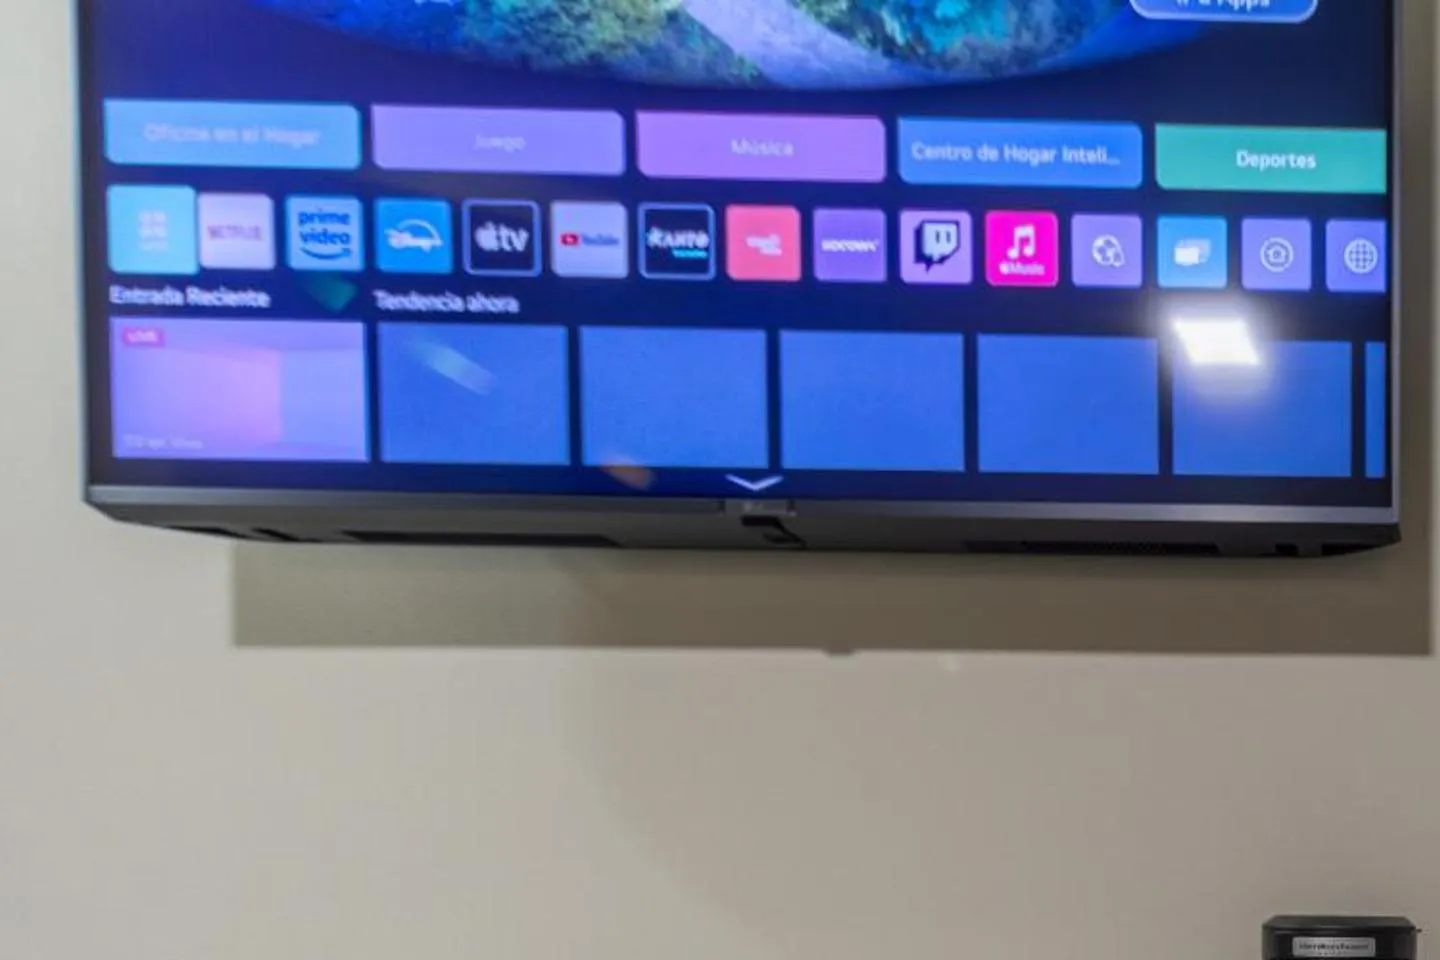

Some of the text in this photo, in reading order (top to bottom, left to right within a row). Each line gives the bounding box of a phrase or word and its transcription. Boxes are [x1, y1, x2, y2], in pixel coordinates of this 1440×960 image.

[474, 134, 525, 154] Juego
[911, 141, 971, 160] Centro
[976, 143, 999, 161] de
[1003, 145, 1056, 166] Hogar
[1236, 149, 1316, 170] Deportes
[297, 208, 350, 226] prime
[299, 227, 350, 244] video
[109, 284, 271, 308] Entrada Reciente
[373, 289, 520, 314] Tendencia ahora
